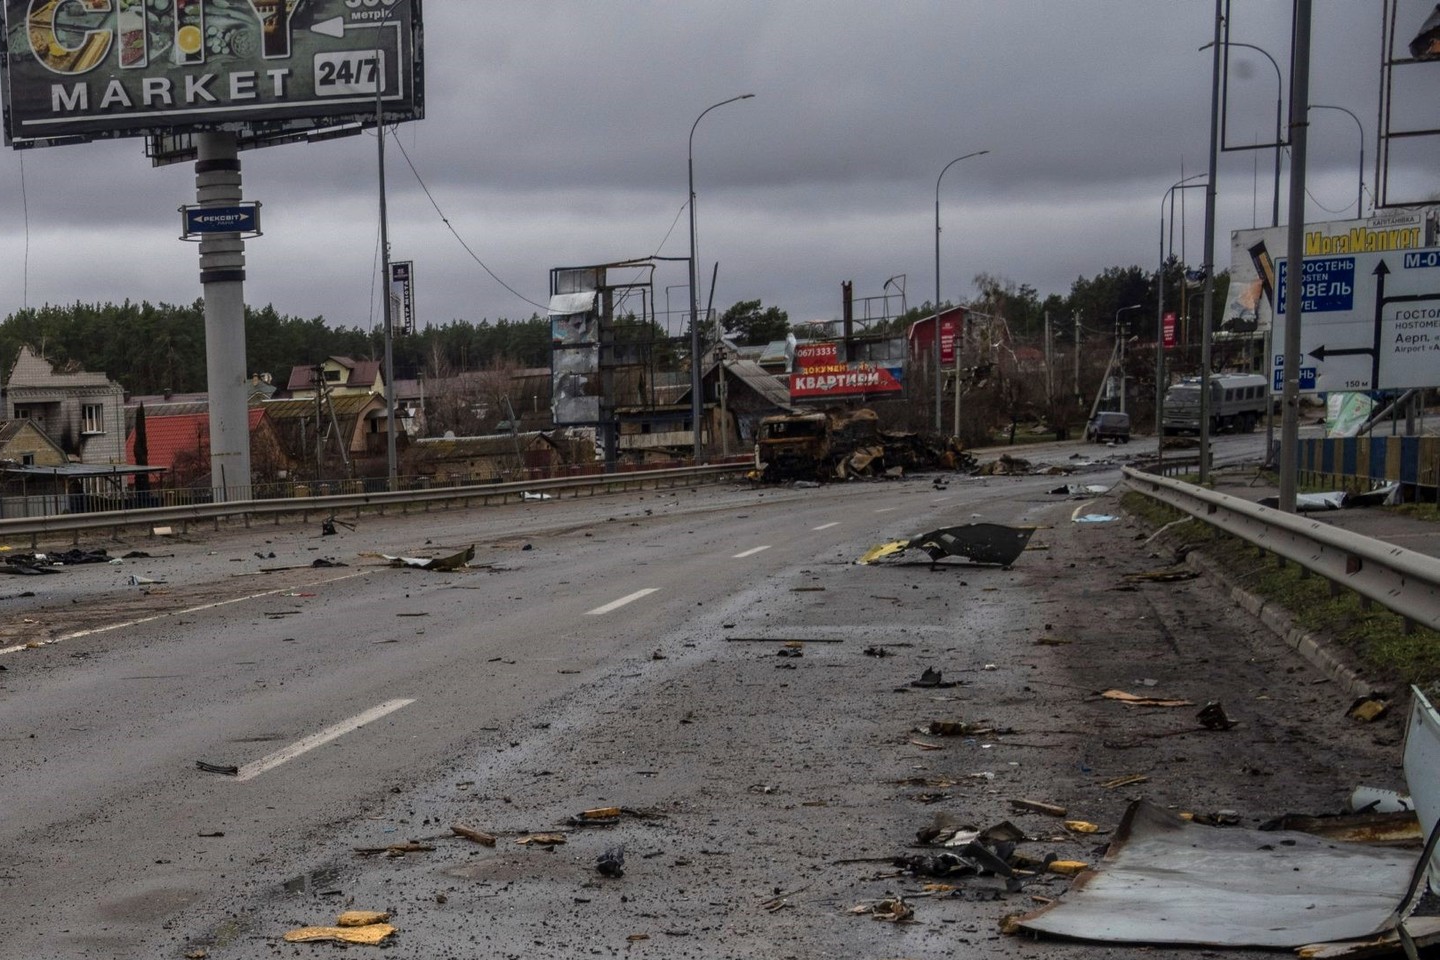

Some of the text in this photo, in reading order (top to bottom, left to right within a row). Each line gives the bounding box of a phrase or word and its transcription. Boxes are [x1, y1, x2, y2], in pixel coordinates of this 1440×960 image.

[318, 58, 380, 86] 24/7
[51, 68, 289, 111] MARKET
[1281, 260, 1354, 275] КОСТЕНЬ
[1405, 252, 1440, 268] М-0
[1280, 274, 1329, 284] KOSTEN
[1395, 320, 1440, 330] HOSTOME
[1345, 380, 1360, 388] 150
